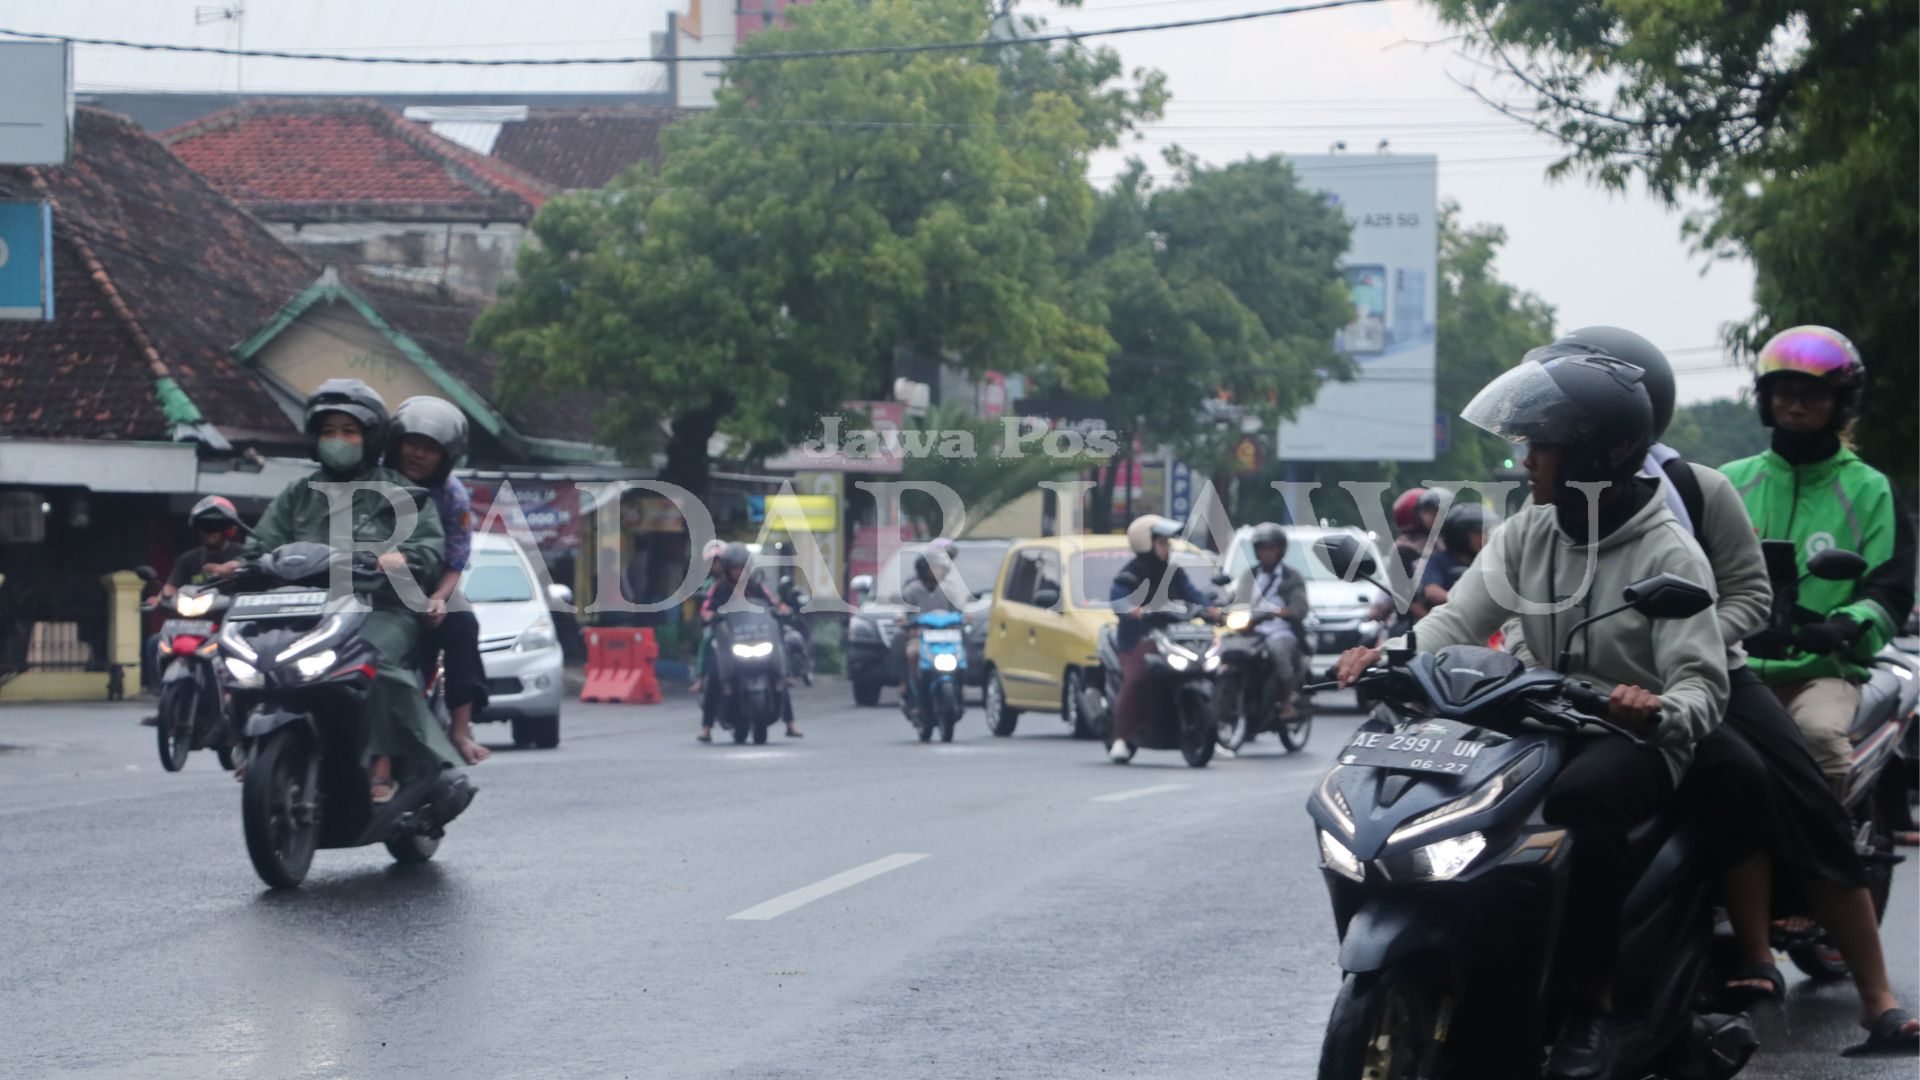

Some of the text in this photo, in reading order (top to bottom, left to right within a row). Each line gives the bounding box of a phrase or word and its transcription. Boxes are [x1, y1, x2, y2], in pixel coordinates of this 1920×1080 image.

[1352, 732, 1486, 759] AE 2991 UN
